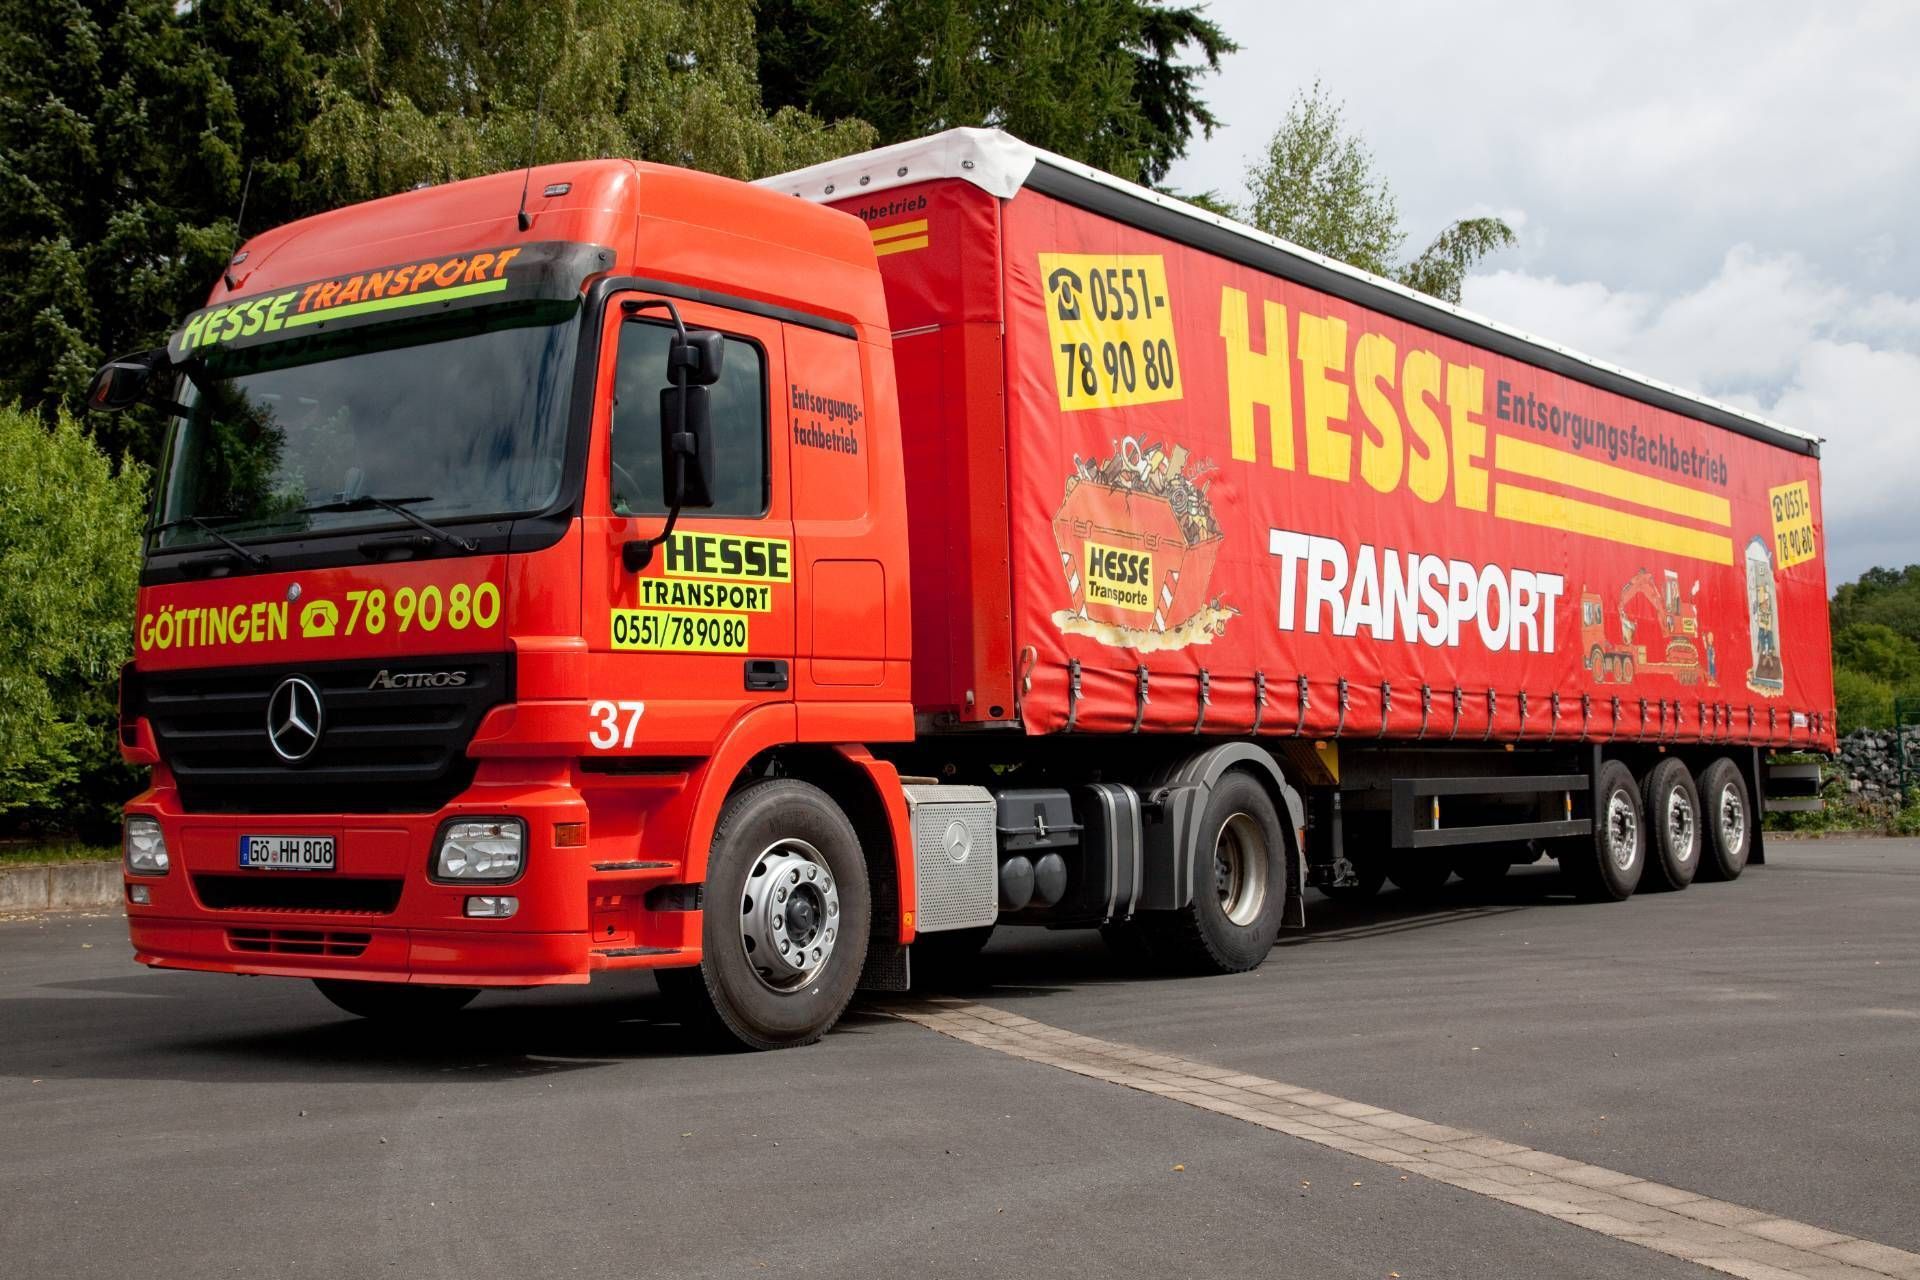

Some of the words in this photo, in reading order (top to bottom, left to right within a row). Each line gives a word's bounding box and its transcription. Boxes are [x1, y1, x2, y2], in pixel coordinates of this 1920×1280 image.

[856, 195, 927, 221] hbetrieb
[179, 291, 299, 351] HESSE
[297, 248, 521, 313] TRANSPORT
[1089, 268, 1165, 322] 0551-
[1060, 342, 1098, 398] 78
[1103, 340, 1136, 395] 90
[1144, 338, 1174, 391] 80
[791, 384, 862, 425] Entsorgungs-
[1219, 285, 1489, 513] HESSE
[794, 417, 858, 455] fachbetrieb
[1496, 380, 1728, 486] Entsorgungsfachbetrieb
[665, 534, 789, 578] HESSE
[1089, 546, 1150, 586] HESSE
[642, 580, 769, 610] TRANSPORT
[1089, 580, 1148, 606] Transporte
[1268, 527, 1564, 653] TRANSPORT
[140, 602, 289, 651] GÖTTINGEN
[589, 700, 645, 750] 37
[250, 840, 269, 862] GÖ
[280, 840, 299, 863] HH
[303, 841, 333, 863] 808
